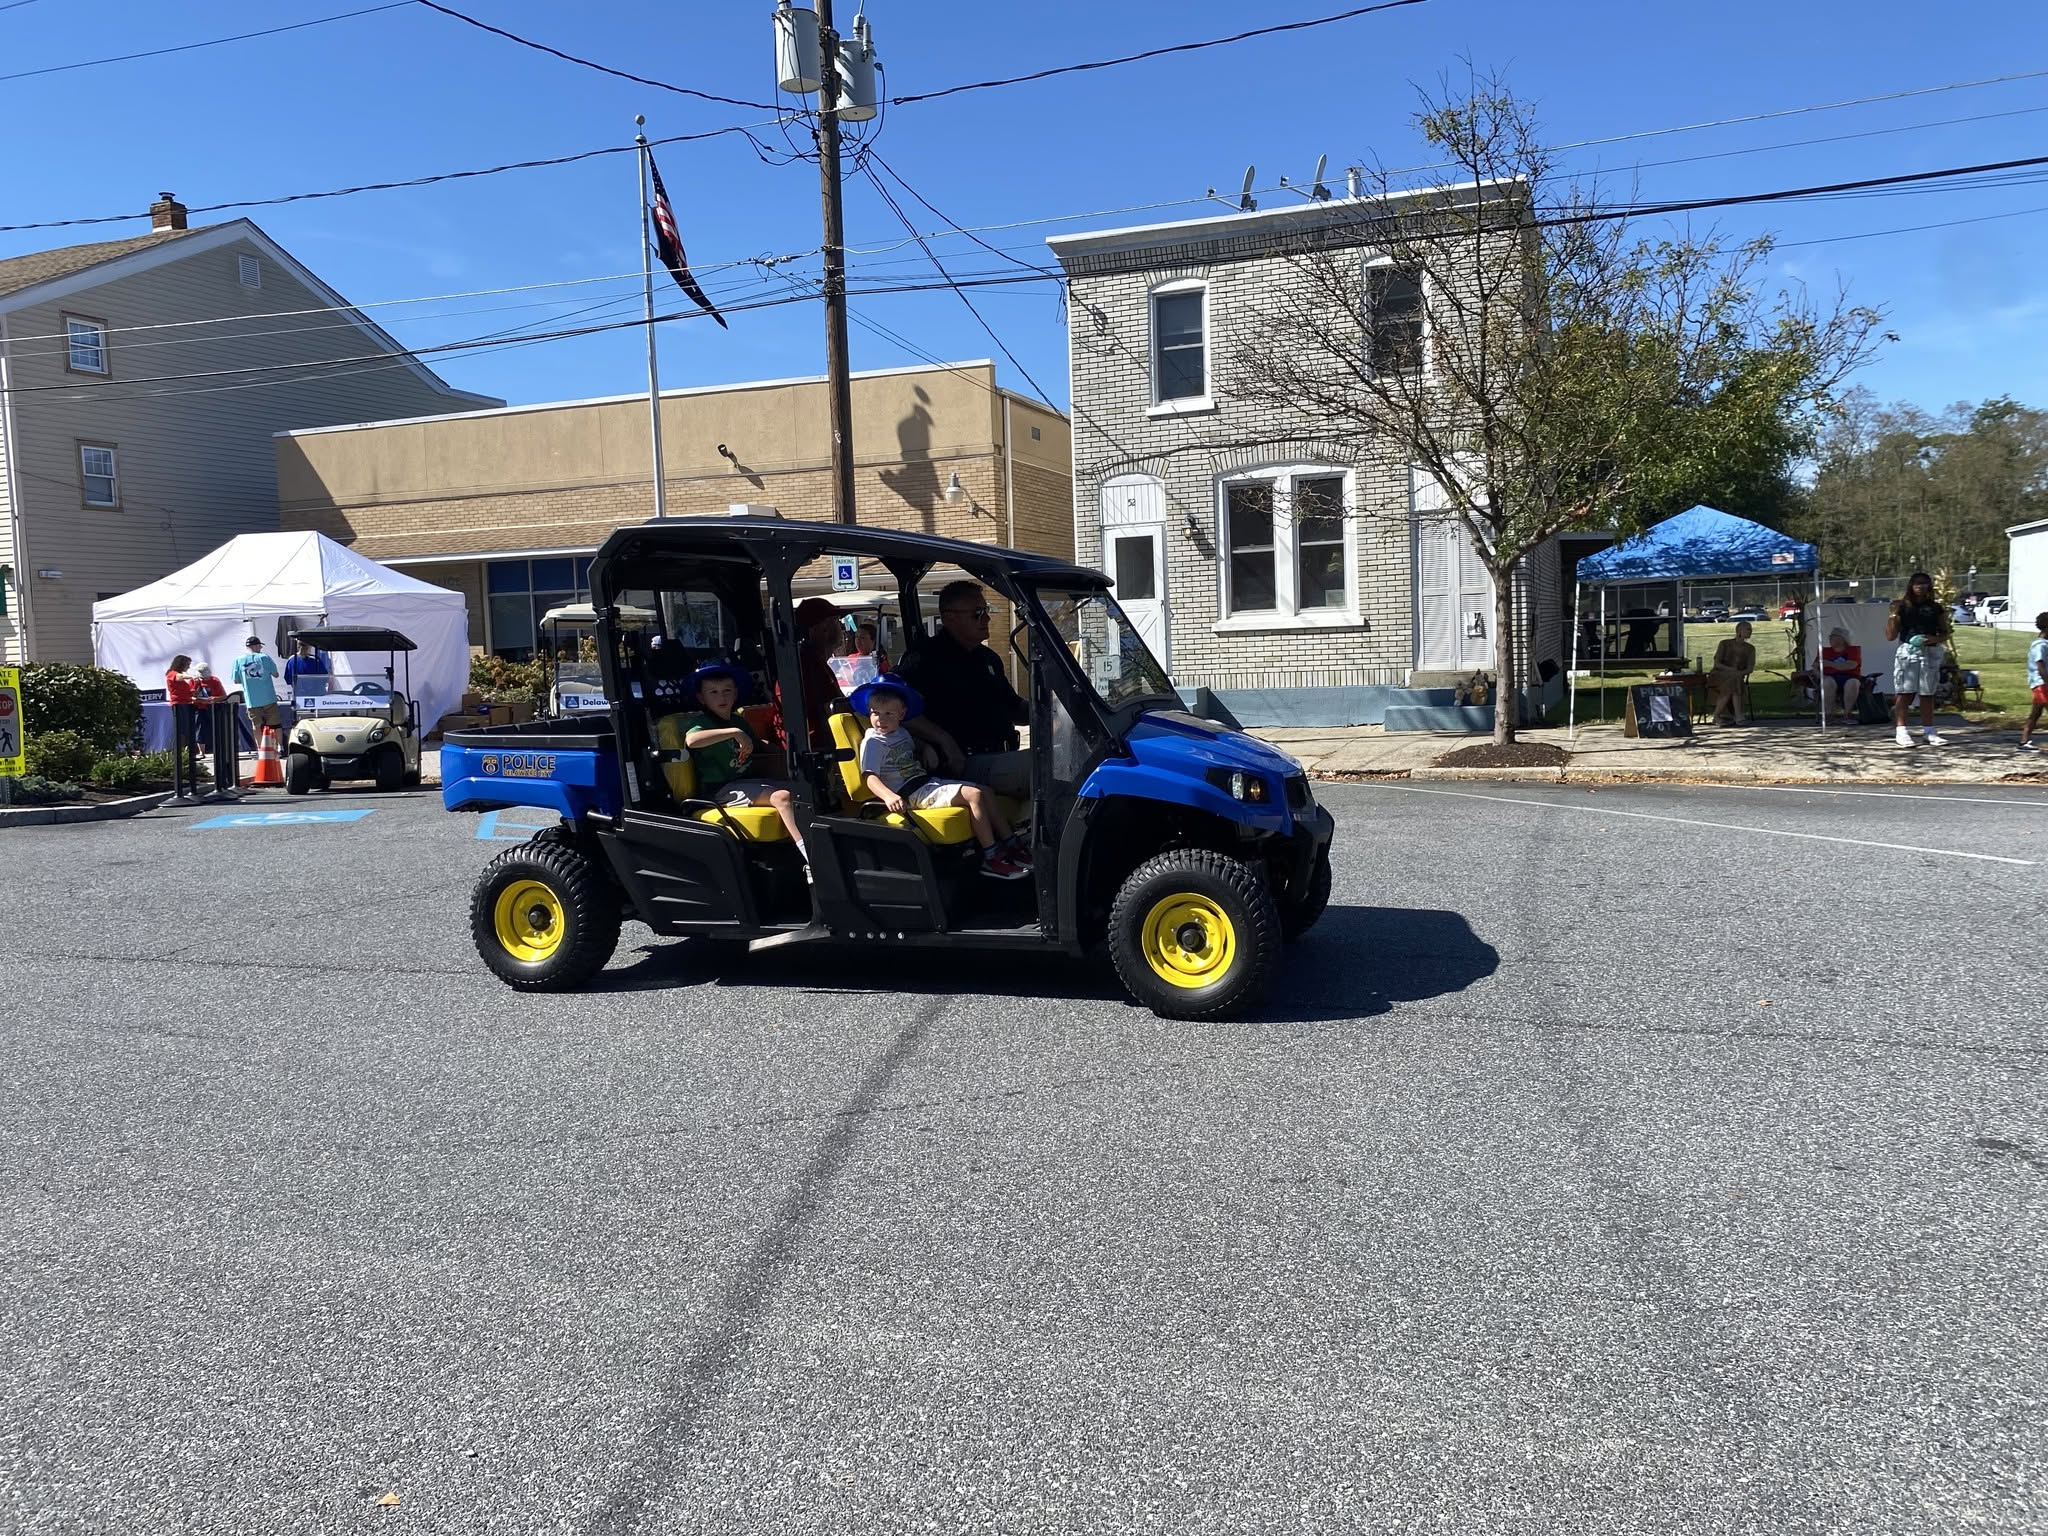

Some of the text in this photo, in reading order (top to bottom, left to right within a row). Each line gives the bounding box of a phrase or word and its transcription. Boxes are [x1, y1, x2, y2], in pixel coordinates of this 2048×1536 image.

[1127, 498, 1136, 507] 52
[1103, 660, 1113, 672] 15
[140, 693, 163, 702] TERY
[502, 754, 556, 771] POLICE
